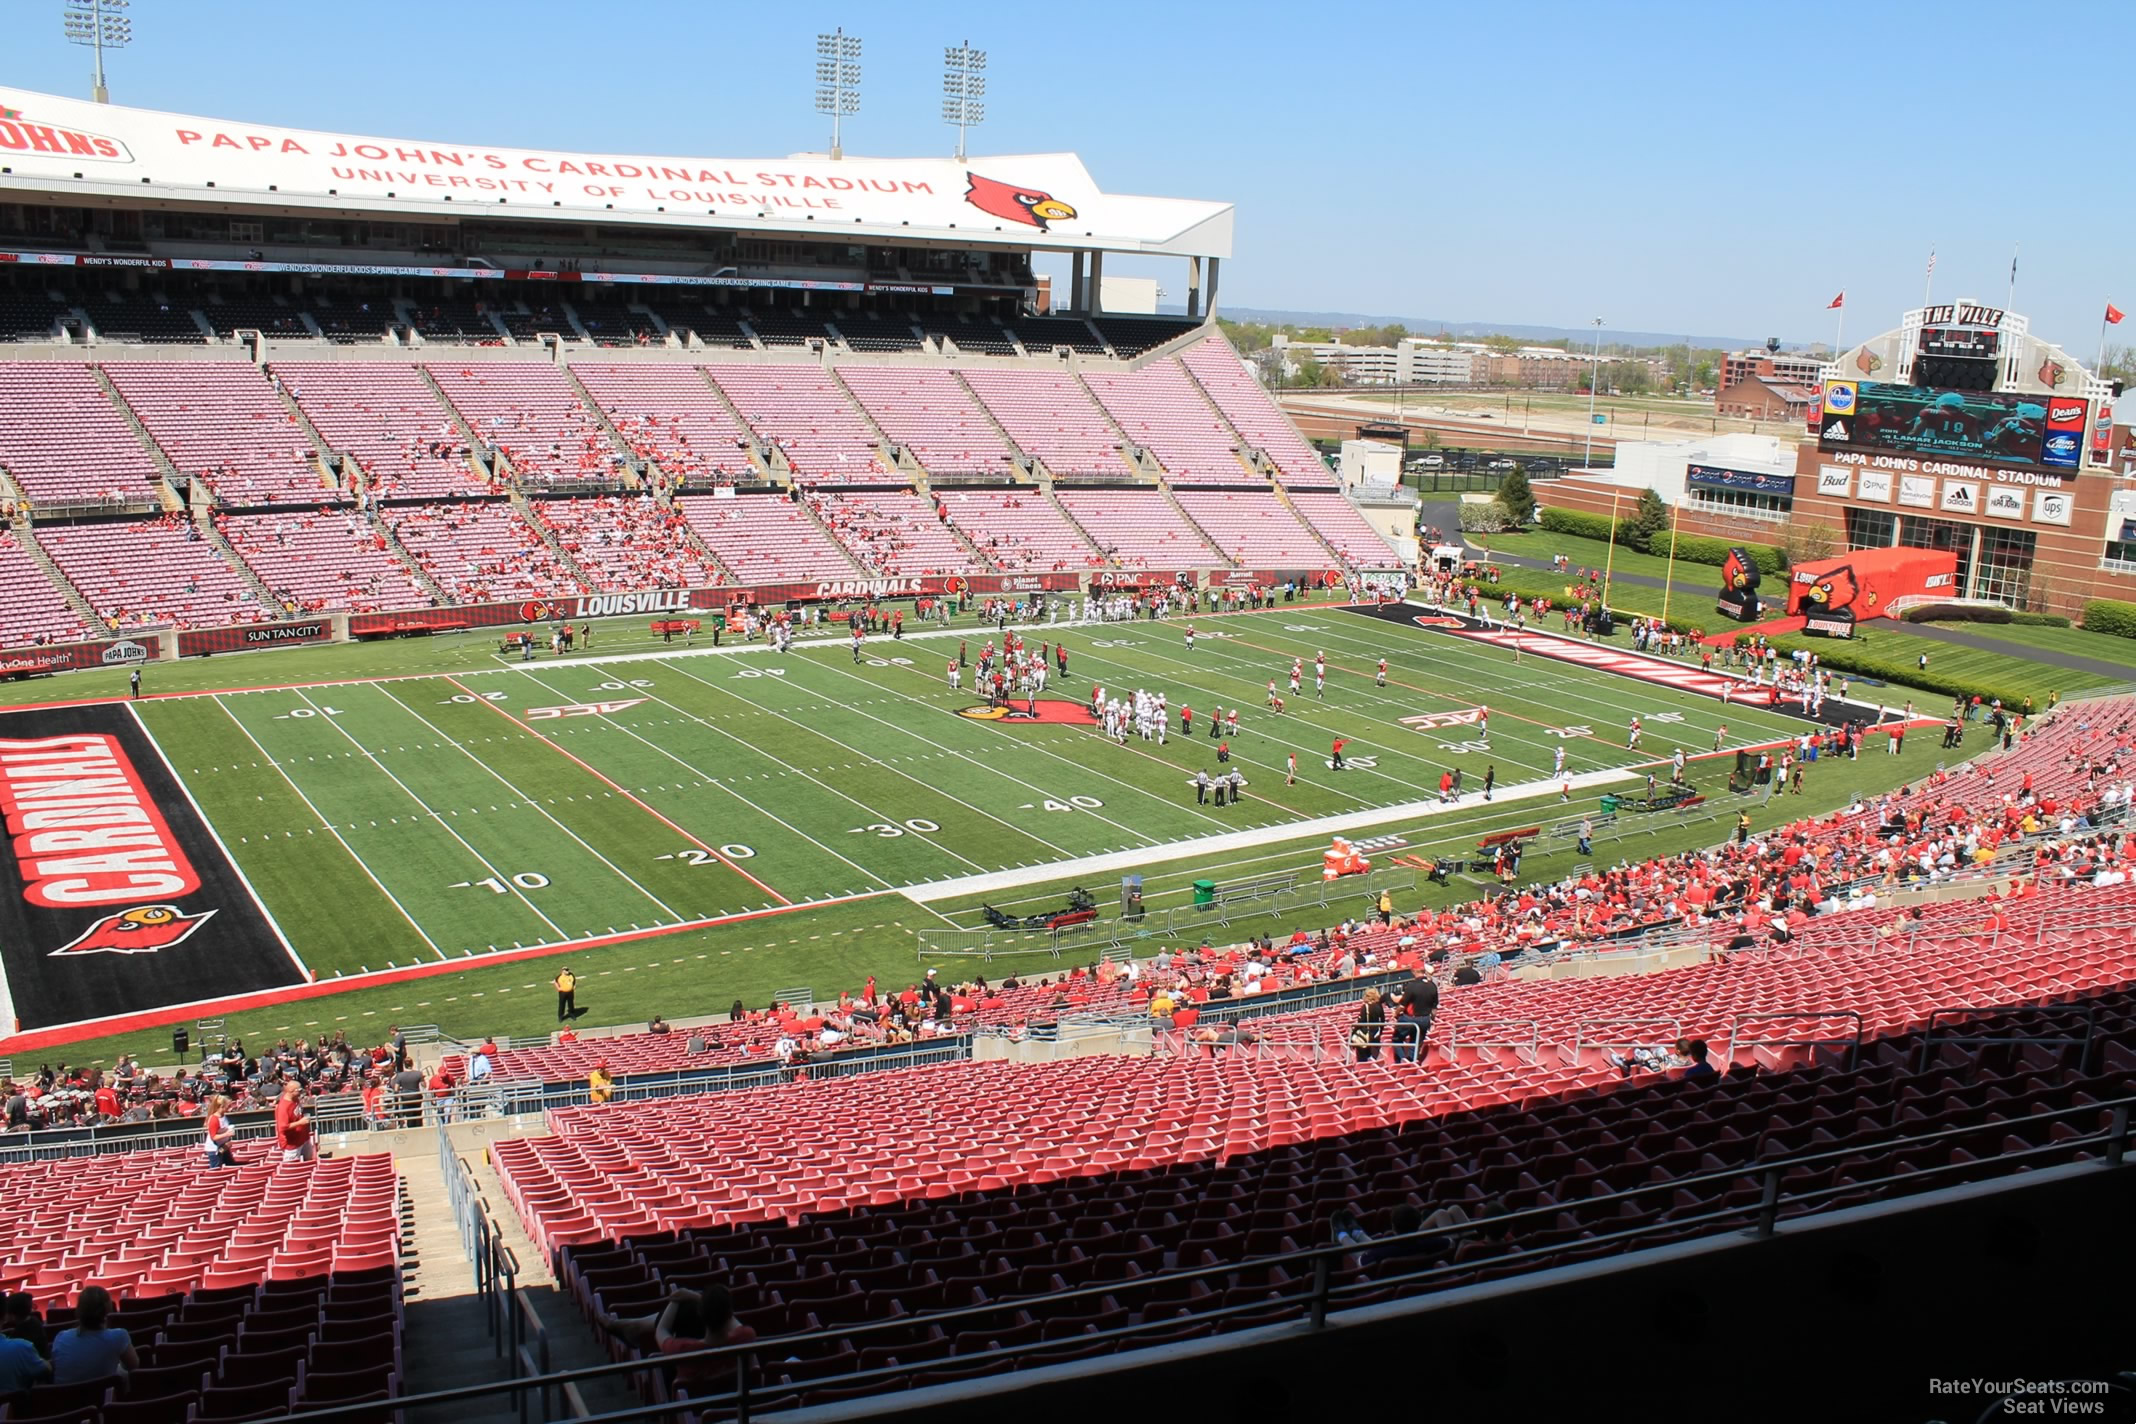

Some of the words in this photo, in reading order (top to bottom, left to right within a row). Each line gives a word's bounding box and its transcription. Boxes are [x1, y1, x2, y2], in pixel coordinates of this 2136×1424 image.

[176, 130, 310, 154] PAPA
[330, 142, 507, 169] JOHN'S
[523, 158, 748, 185] CARDINAL
[756, 172, 934, 195] STADIUM
[331, 167, 554, 193] UNIVERSITY
[584, 185, 625, 198] OF
[648, 188, 843, 209] LOUISVILLE
[83, 257, 112, 265] WENDY'S
[113, 258, 151, 266] WONDERFUL
[152, 259, 167, 267] KIDS
[278, 264, 310, 273] WENDY'S
[311, 265, 353, 273] WONDERFUL
[354, 266, 370, 274] KIDS
[371, 266, 398, 275] SPRING
[399, 267, 420, 275] GAME
[697, 277, 733, 286] WONDERFUL
[733, 278, 748, 287] KIDS
[748, 279, 770, 288] SPRING
[771, 280, 791, 289] GAME
[1924, 306, 1953, 324] THE
[1960, 306, 2002, 327] VILLE
[2052, 407, 2081, 419] Dean's
[1823, 432, 1849, 441] adidas
[1893, 435, 1931, 443] LAMAR
[1932, 439, 1983, 449] JACKSON
[2055, 438, 2075, 446] BUD
[2050, 442, 2077, 451] LIGHT
[1835, 452, 1867, 466] PAPA
[1872, 456, 1918, 471] JOHN'S
[1922, 461, 1991, 480] CARDINAL
[1997, 469, 2061, 488] STADIUM
[1822, 475, 1849, 487] Bud
[1871, 482, 1887, 491] PNC
[1946, 497, 1973, 507] adidas
[2045, 502, 2061, 515] ups
[1013, 576, 1038, 585] planet
[1116, 573, 1143, 585] PNC
[817, 578, 922, 598] CARDINALS
[1015, 582, 1042, 590] fitness
[577, 591, 689, 617] LOUISVILLE
[1809, 620, 1851, 633] LOUISVILLE
[248, 629, 272, 641] SUN
[272, 627, 296, 639] TAN
[296, 625, 322, 637] CITY
[38, 654, 70, 665] Health
[105, 648, 122, 660] PAPA
[866, 657, 915, 667] 50
[738, 668, 786, 678] 40
[600, 679, 655, 690] 30
[451, 691, 509, 704] 20
[290, 706, 344, 718] 10
[525, 698, 650, 721] ACC
[1398, 708, 1483, 730] ACC
[1644, 712, 1686, 723] 10
[1544, 726, 1595, 738] 20
[1437, 740, 1492, 754] 30
[1043, 795, 1105, 812] 40
[0, 736, 186, 903] CARDINALS
[867, 818, 941, 838] 30
[678, 844, 757, 866] 20
[1344, 857, 1352, 867] G
[476, 872, 551, 894] 10
